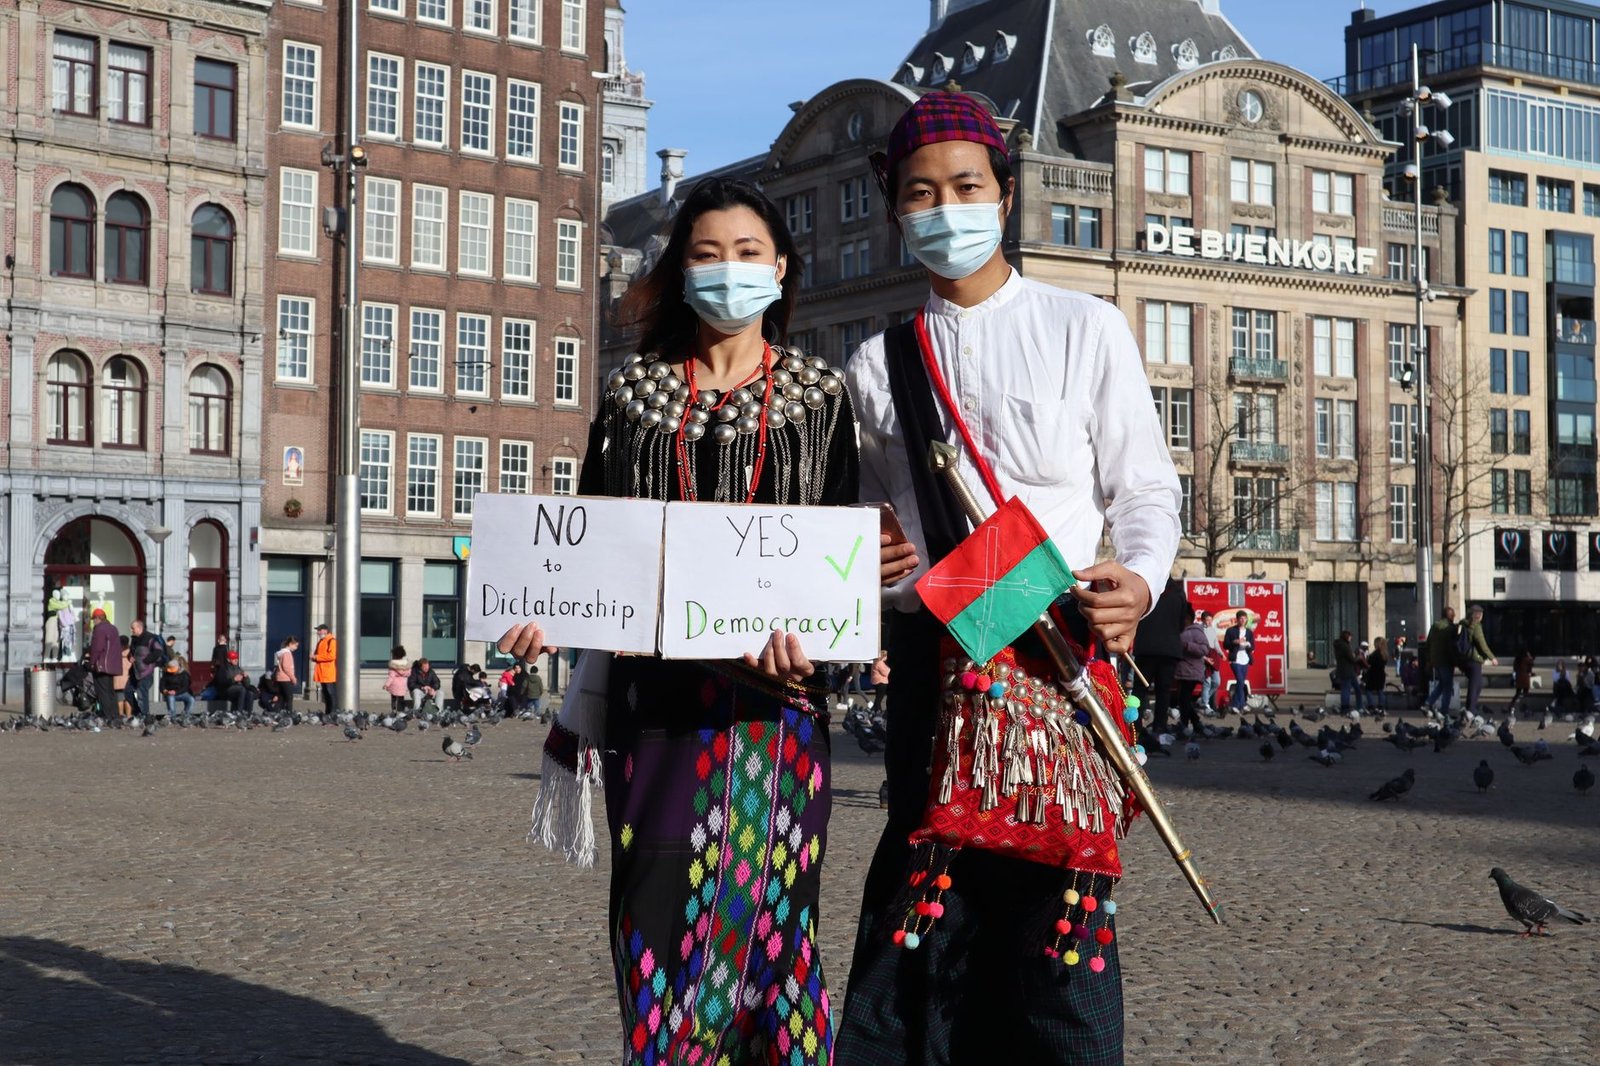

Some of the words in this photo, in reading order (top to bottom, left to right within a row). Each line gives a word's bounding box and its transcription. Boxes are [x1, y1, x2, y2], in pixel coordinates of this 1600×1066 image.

[1146, 222, 1195, 257] DE
[1200, 228, 1378, 275] BIJENKORF
[533, 503, 587, 547] NO
[726, 513, 799, 558] YES
[542, 558, 562, 573] to
[757, 577, 772, 589] to
[482, 583, 635, 630] Dictatorship
